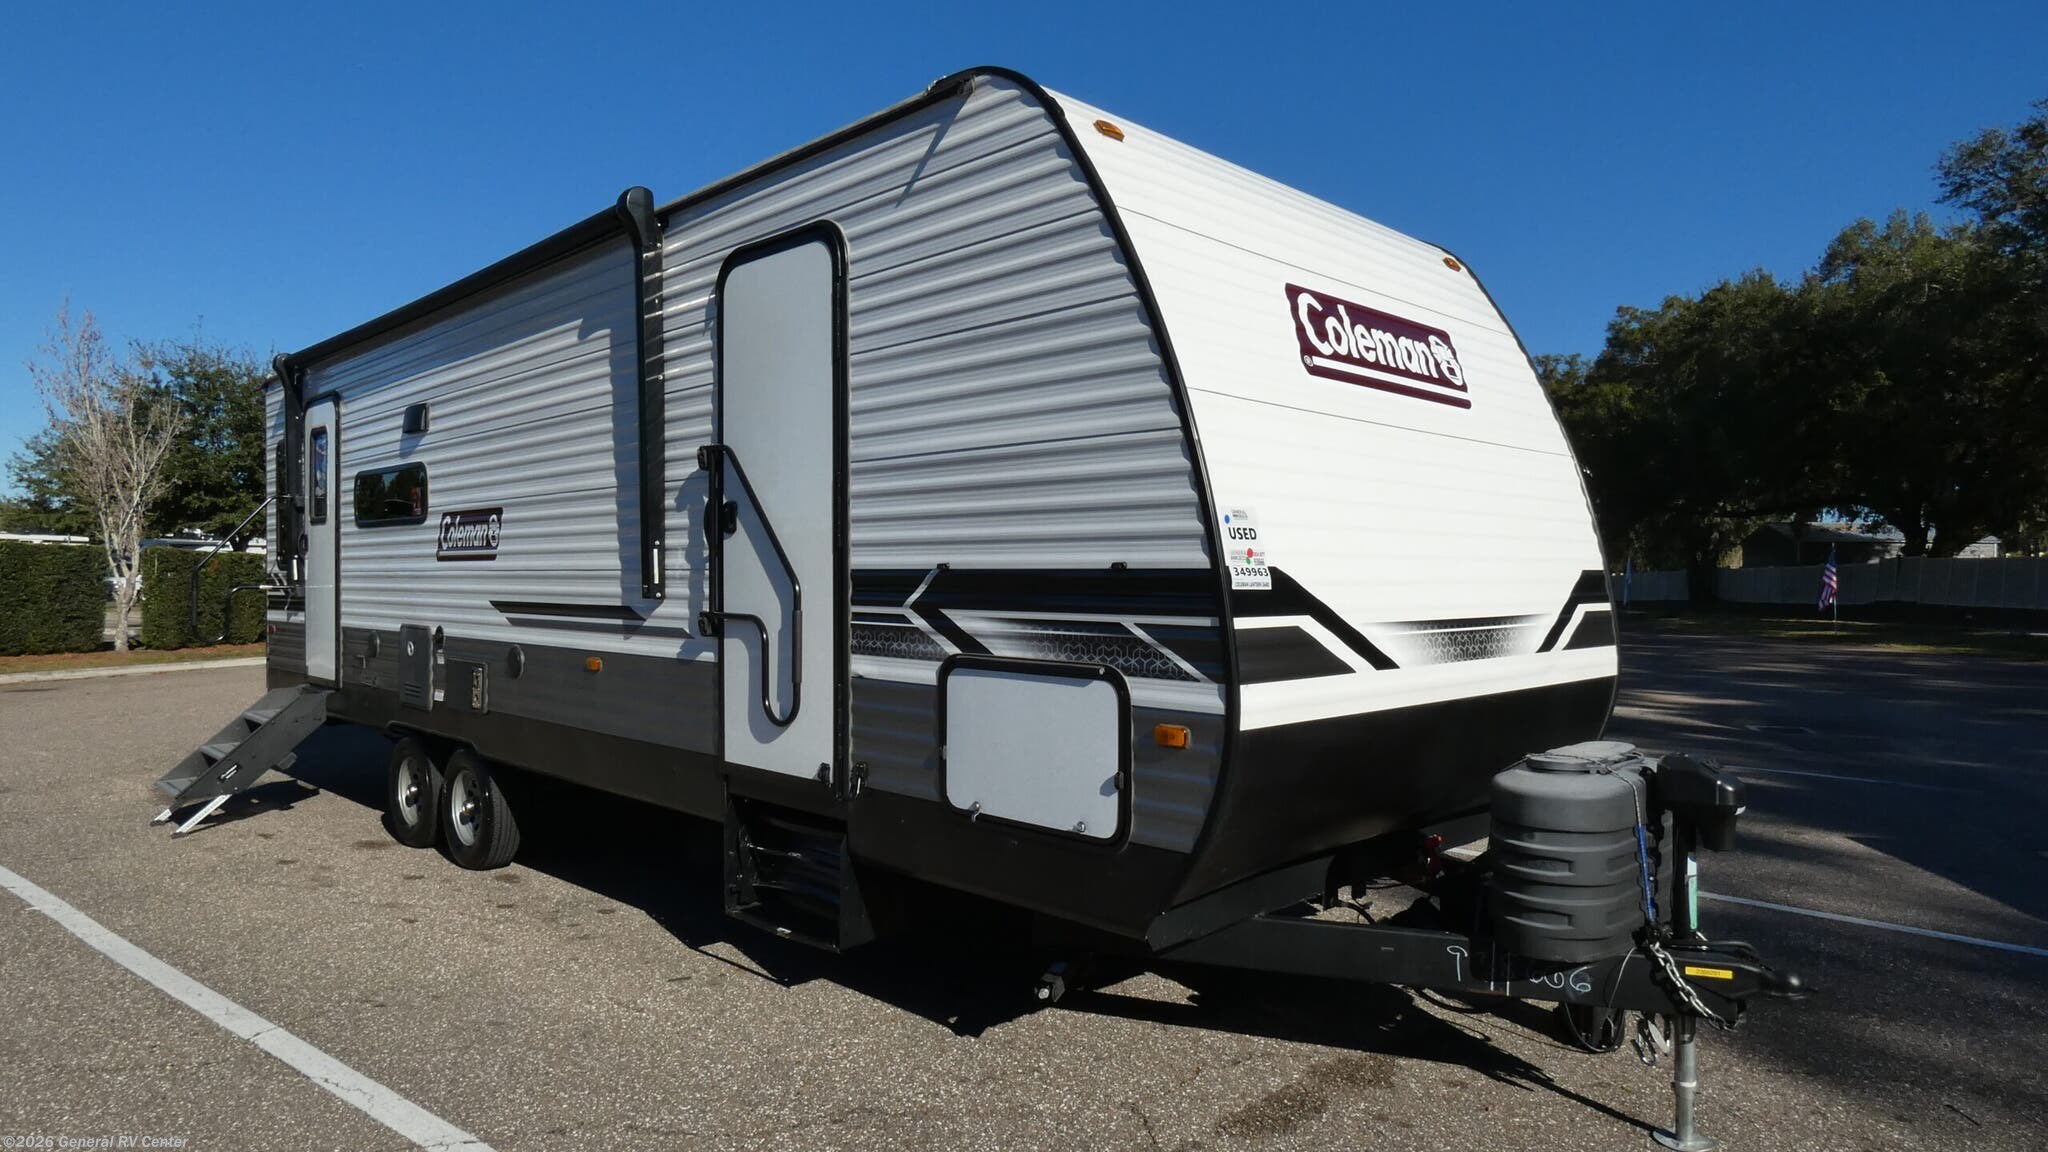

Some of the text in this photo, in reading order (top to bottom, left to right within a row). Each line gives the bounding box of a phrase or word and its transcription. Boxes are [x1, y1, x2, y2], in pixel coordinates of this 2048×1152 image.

[1297, 292, 1439, 379] Coleman
[441, 515, 488, 550] Coleman
[1228, 527, 1257, 540] USED
[1233, 567, 1269, 577] 349963
